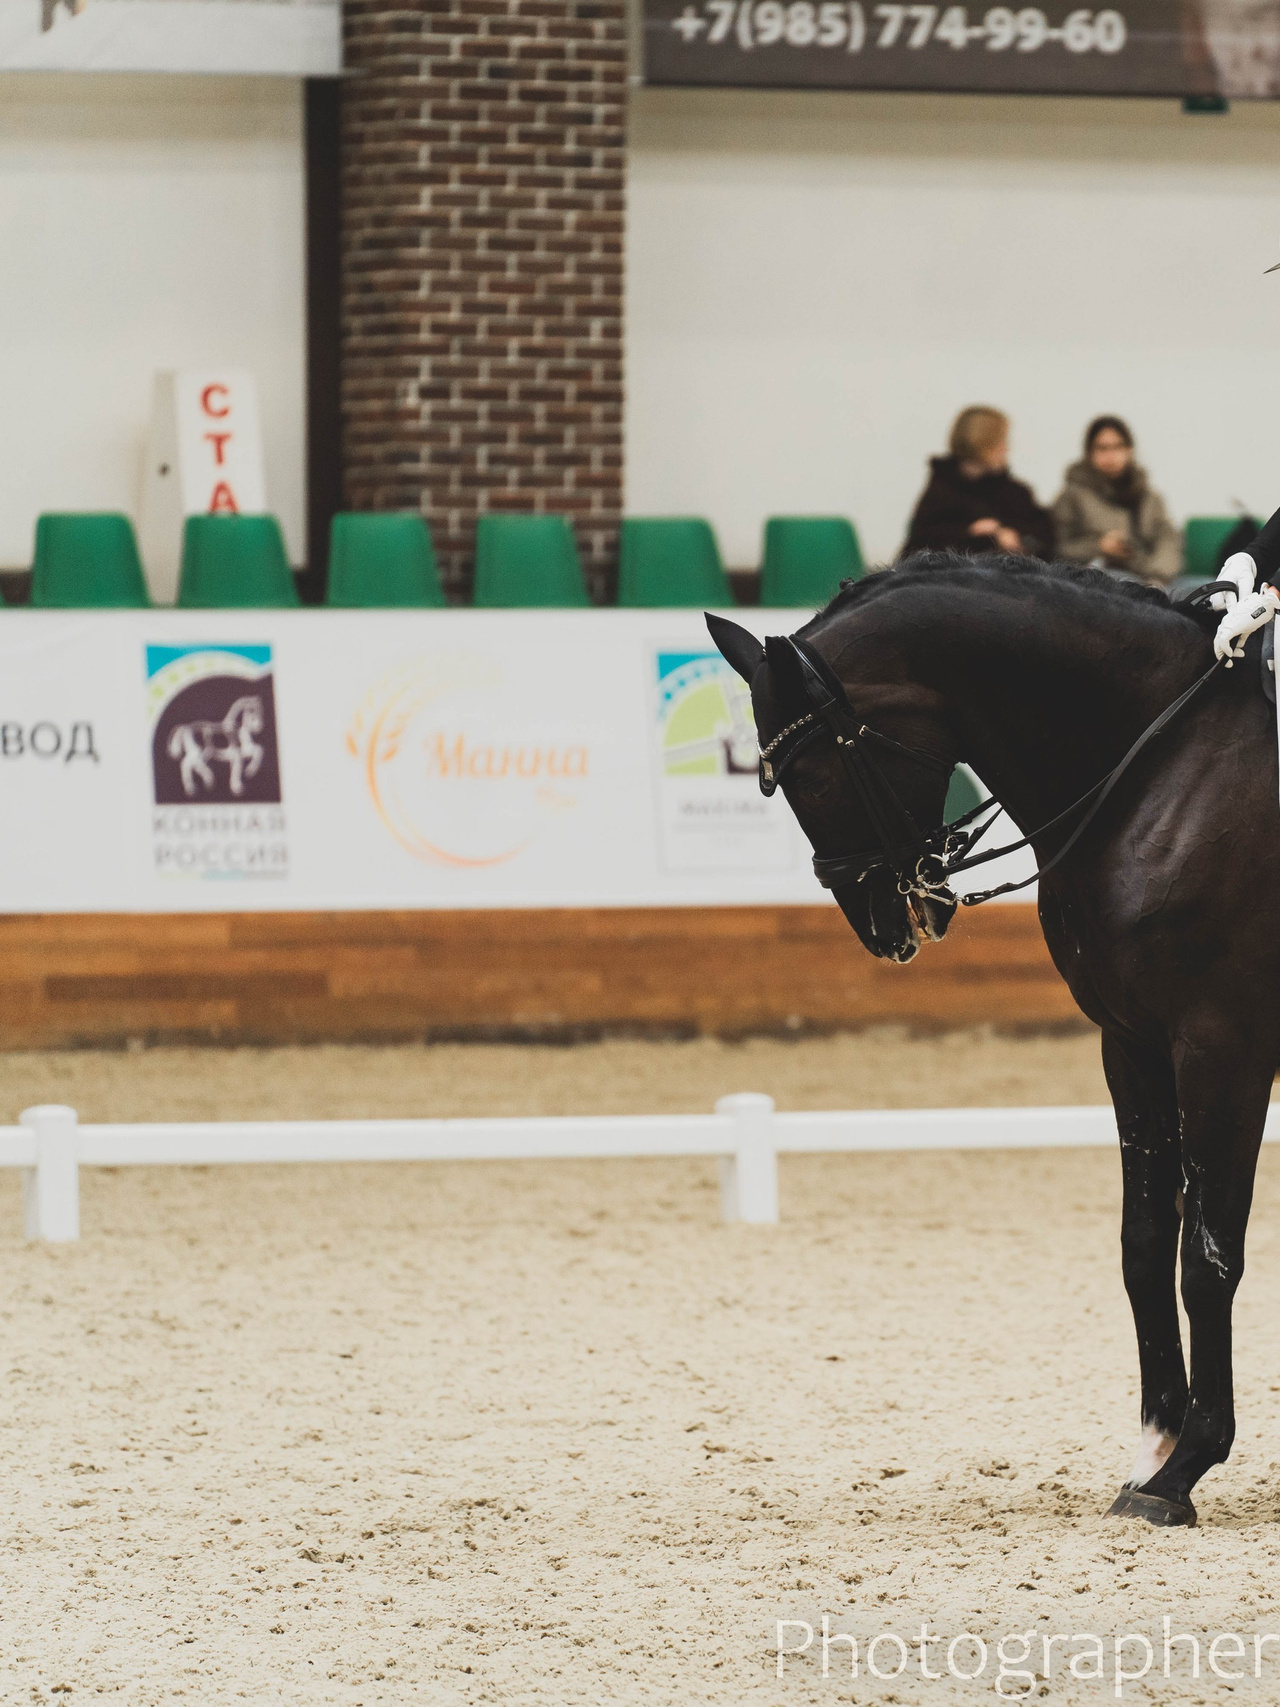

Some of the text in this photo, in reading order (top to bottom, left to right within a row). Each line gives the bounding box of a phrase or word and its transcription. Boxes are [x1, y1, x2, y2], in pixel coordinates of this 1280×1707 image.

[673, 0, 1127, 54] +7(985) 774-99-60
[1, 720, 100, 764] ВОД
[423, 732, 589, 779] Манна
[153, 811, 286, 834] КОННАЯ
[154, 843, 288, 867] РОССИЯ
